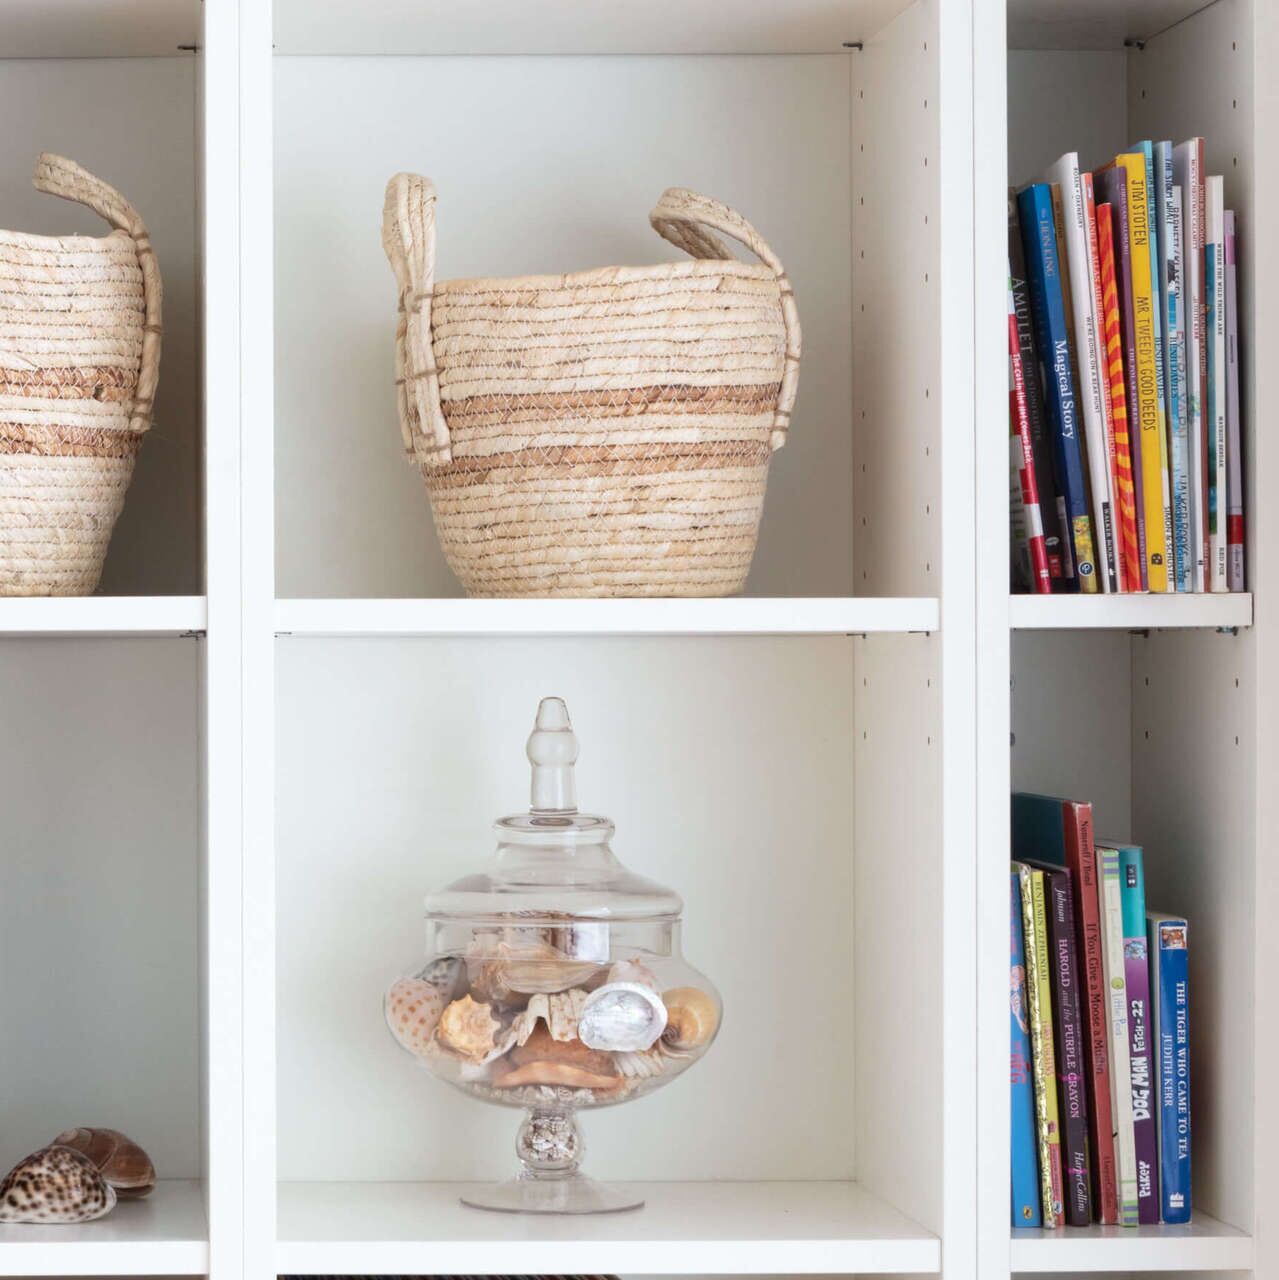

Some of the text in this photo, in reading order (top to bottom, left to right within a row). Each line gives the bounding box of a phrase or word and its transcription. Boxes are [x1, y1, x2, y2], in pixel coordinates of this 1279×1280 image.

[1132, 180, 1146, 246] JIM STOTEN
[1054, 340, 1076, 440] Magical Story
[1136, 296, 1156, 432] MR TWEED'S GOOD DEEDS
[1059, 939, 1071, 987] HAROLD
[1064, 1024, 1077, 1070] PURPLE
[1163, 1033, 1174, 1107] JUDITH KERR
[1176, 981, 1188, 1159] THE TIGER WHO CAME TO TEA
[1066, 1072, 1079, 1118] CRAYON
[1130, 1056, 1151, 1121] DOG MAN
